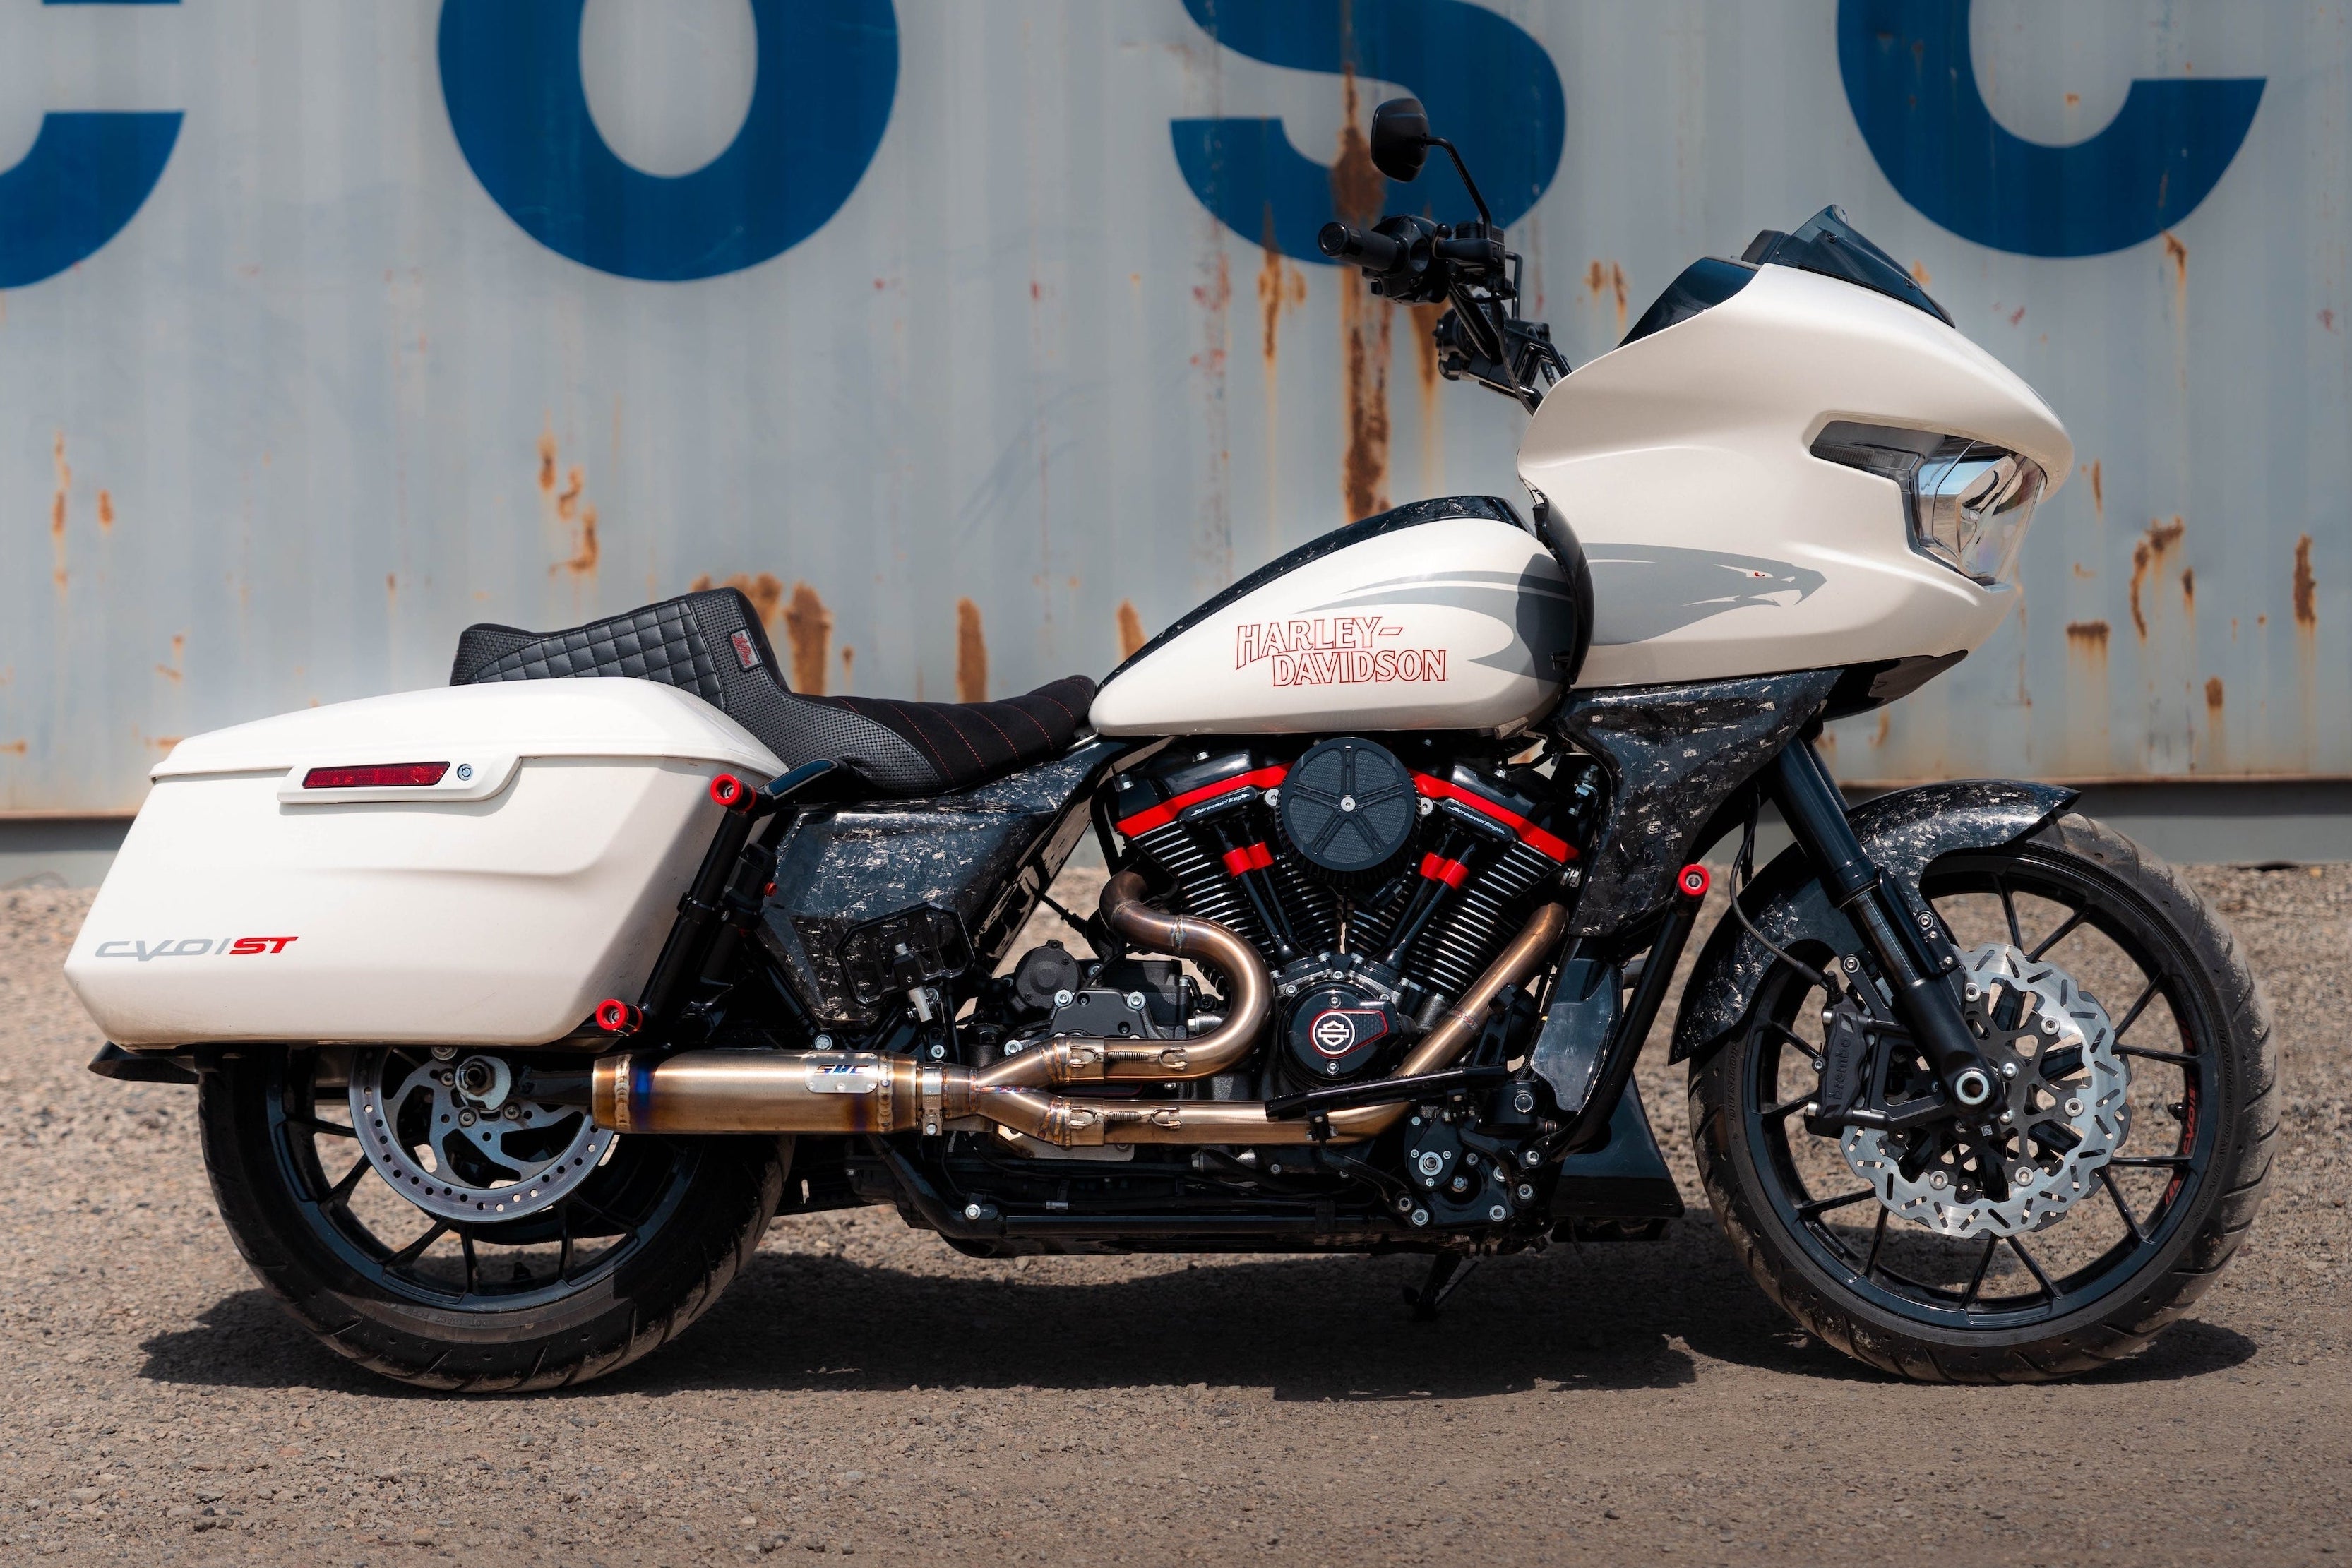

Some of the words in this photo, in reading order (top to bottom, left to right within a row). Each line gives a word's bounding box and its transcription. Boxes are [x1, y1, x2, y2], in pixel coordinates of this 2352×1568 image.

[1236, 616, 1404, 670] HARLEY-
[1272, 650, 1447, 686] DAVIDSON
[1190, 798, 1229, 816] Screamin'
[1447, 806, 1486, 824] Screamin'
[1828, 1037, 1851, 1100] brembo
